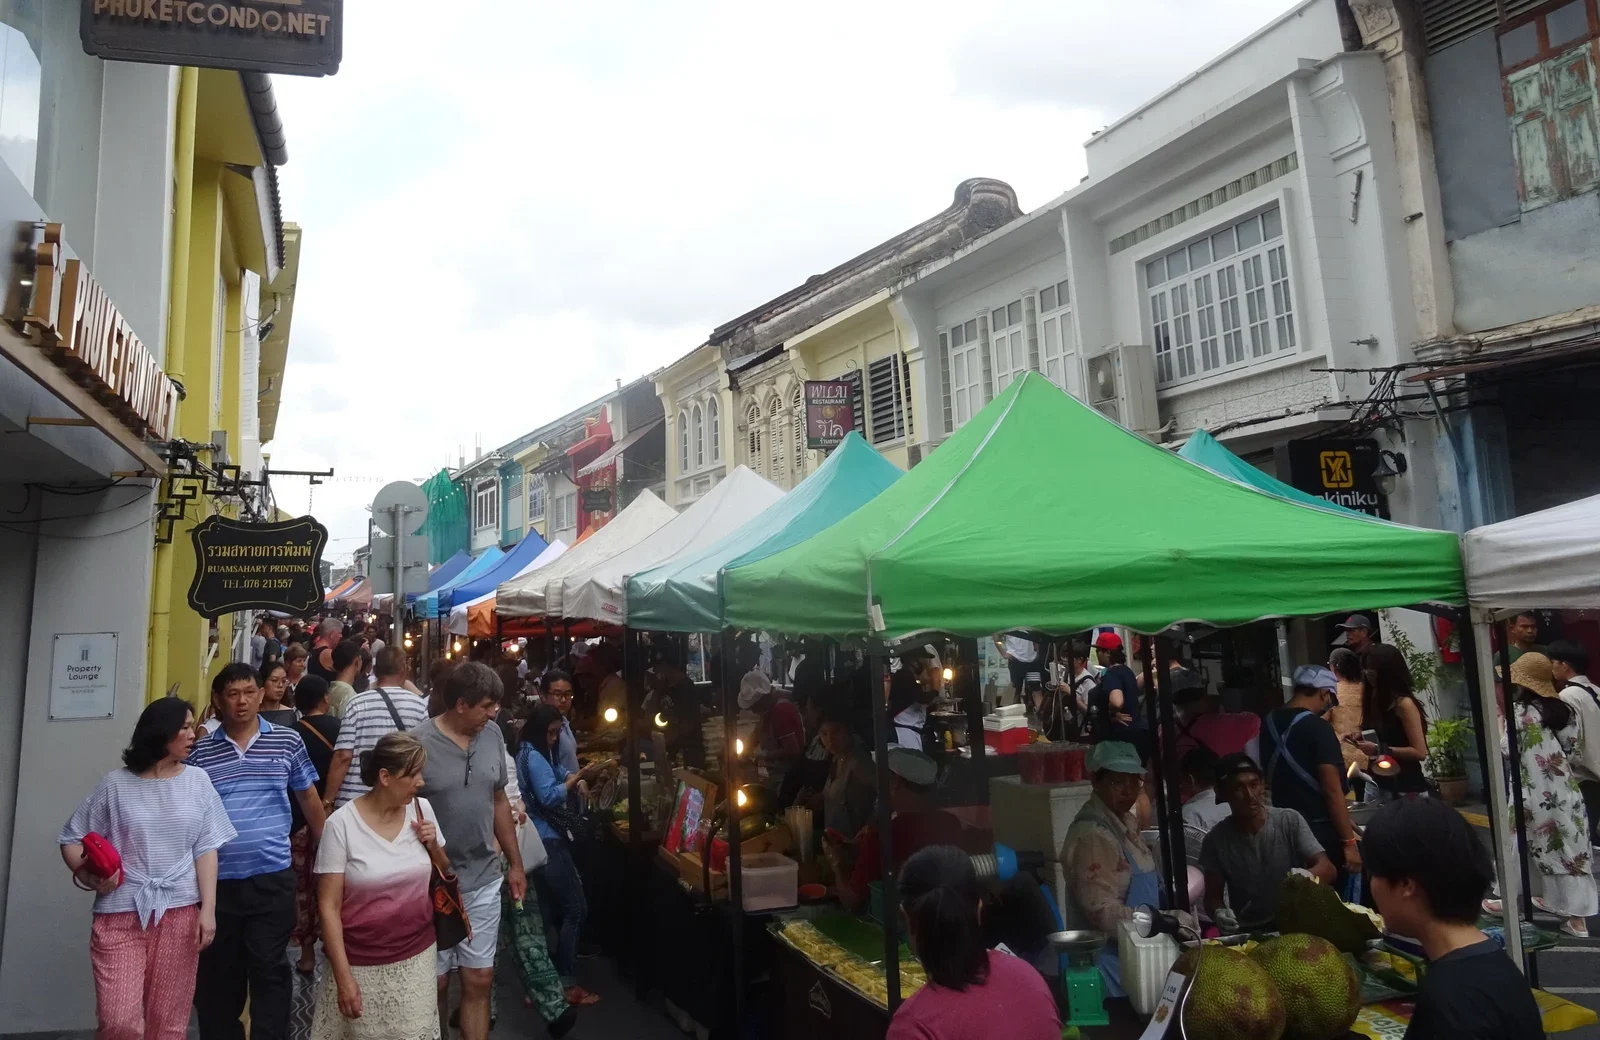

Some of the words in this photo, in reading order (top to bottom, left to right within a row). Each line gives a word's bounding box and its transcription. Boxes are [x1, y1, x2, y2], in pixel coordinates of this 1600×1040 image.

[94, 0, 330, 36] PHUKETCONDO.NET
[811, 385, 848, 398] WILAI
[207, 540, 313, 557] รวมสหายการพิมพ์
[207, 565, 267, 573] RUAMSAHARY
[270, 565, 309, 573] PRINTING
[262, 579, 294, 589] 211557
